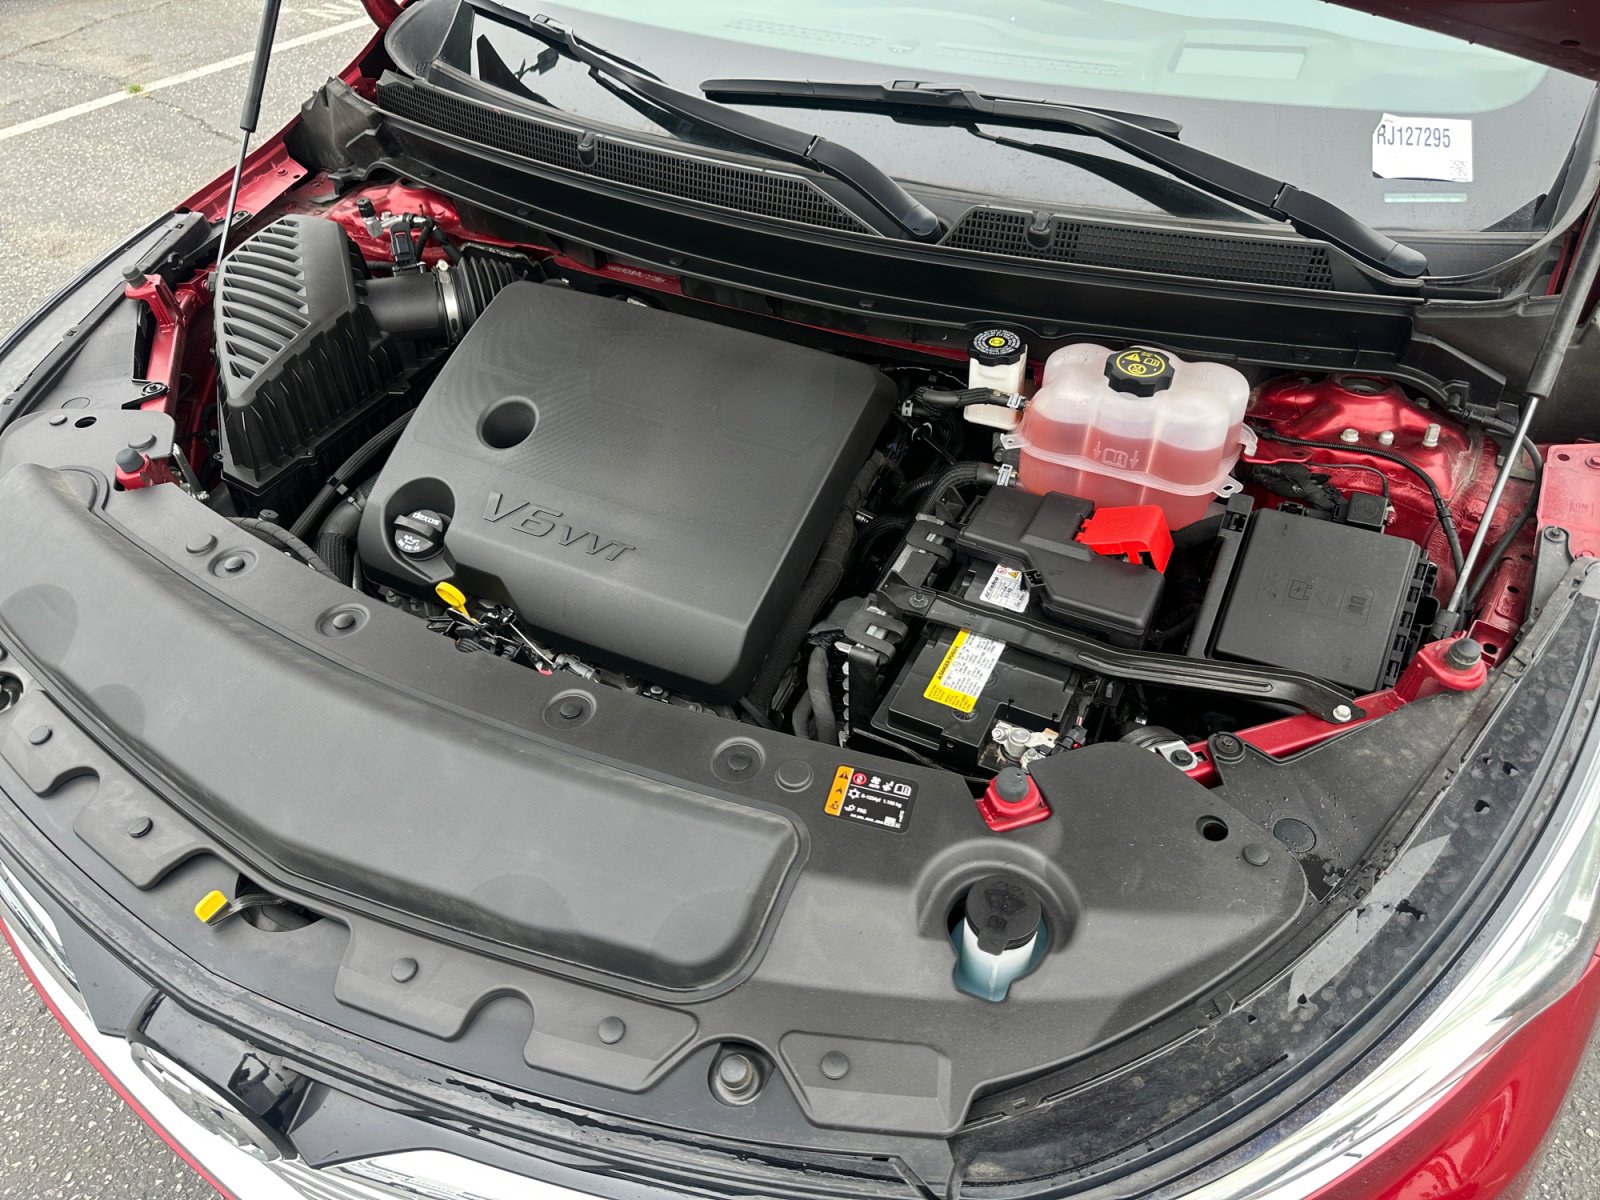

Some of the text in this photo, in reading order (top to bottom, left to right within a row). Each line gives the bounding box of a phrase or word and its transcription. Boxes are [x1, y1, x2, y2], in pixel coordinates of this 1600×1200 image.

[1377, 123, 1451, 148] RJ127295
[412, 511, 441, 526] dexos
[483, 490, 637, 562] V6 VVT
